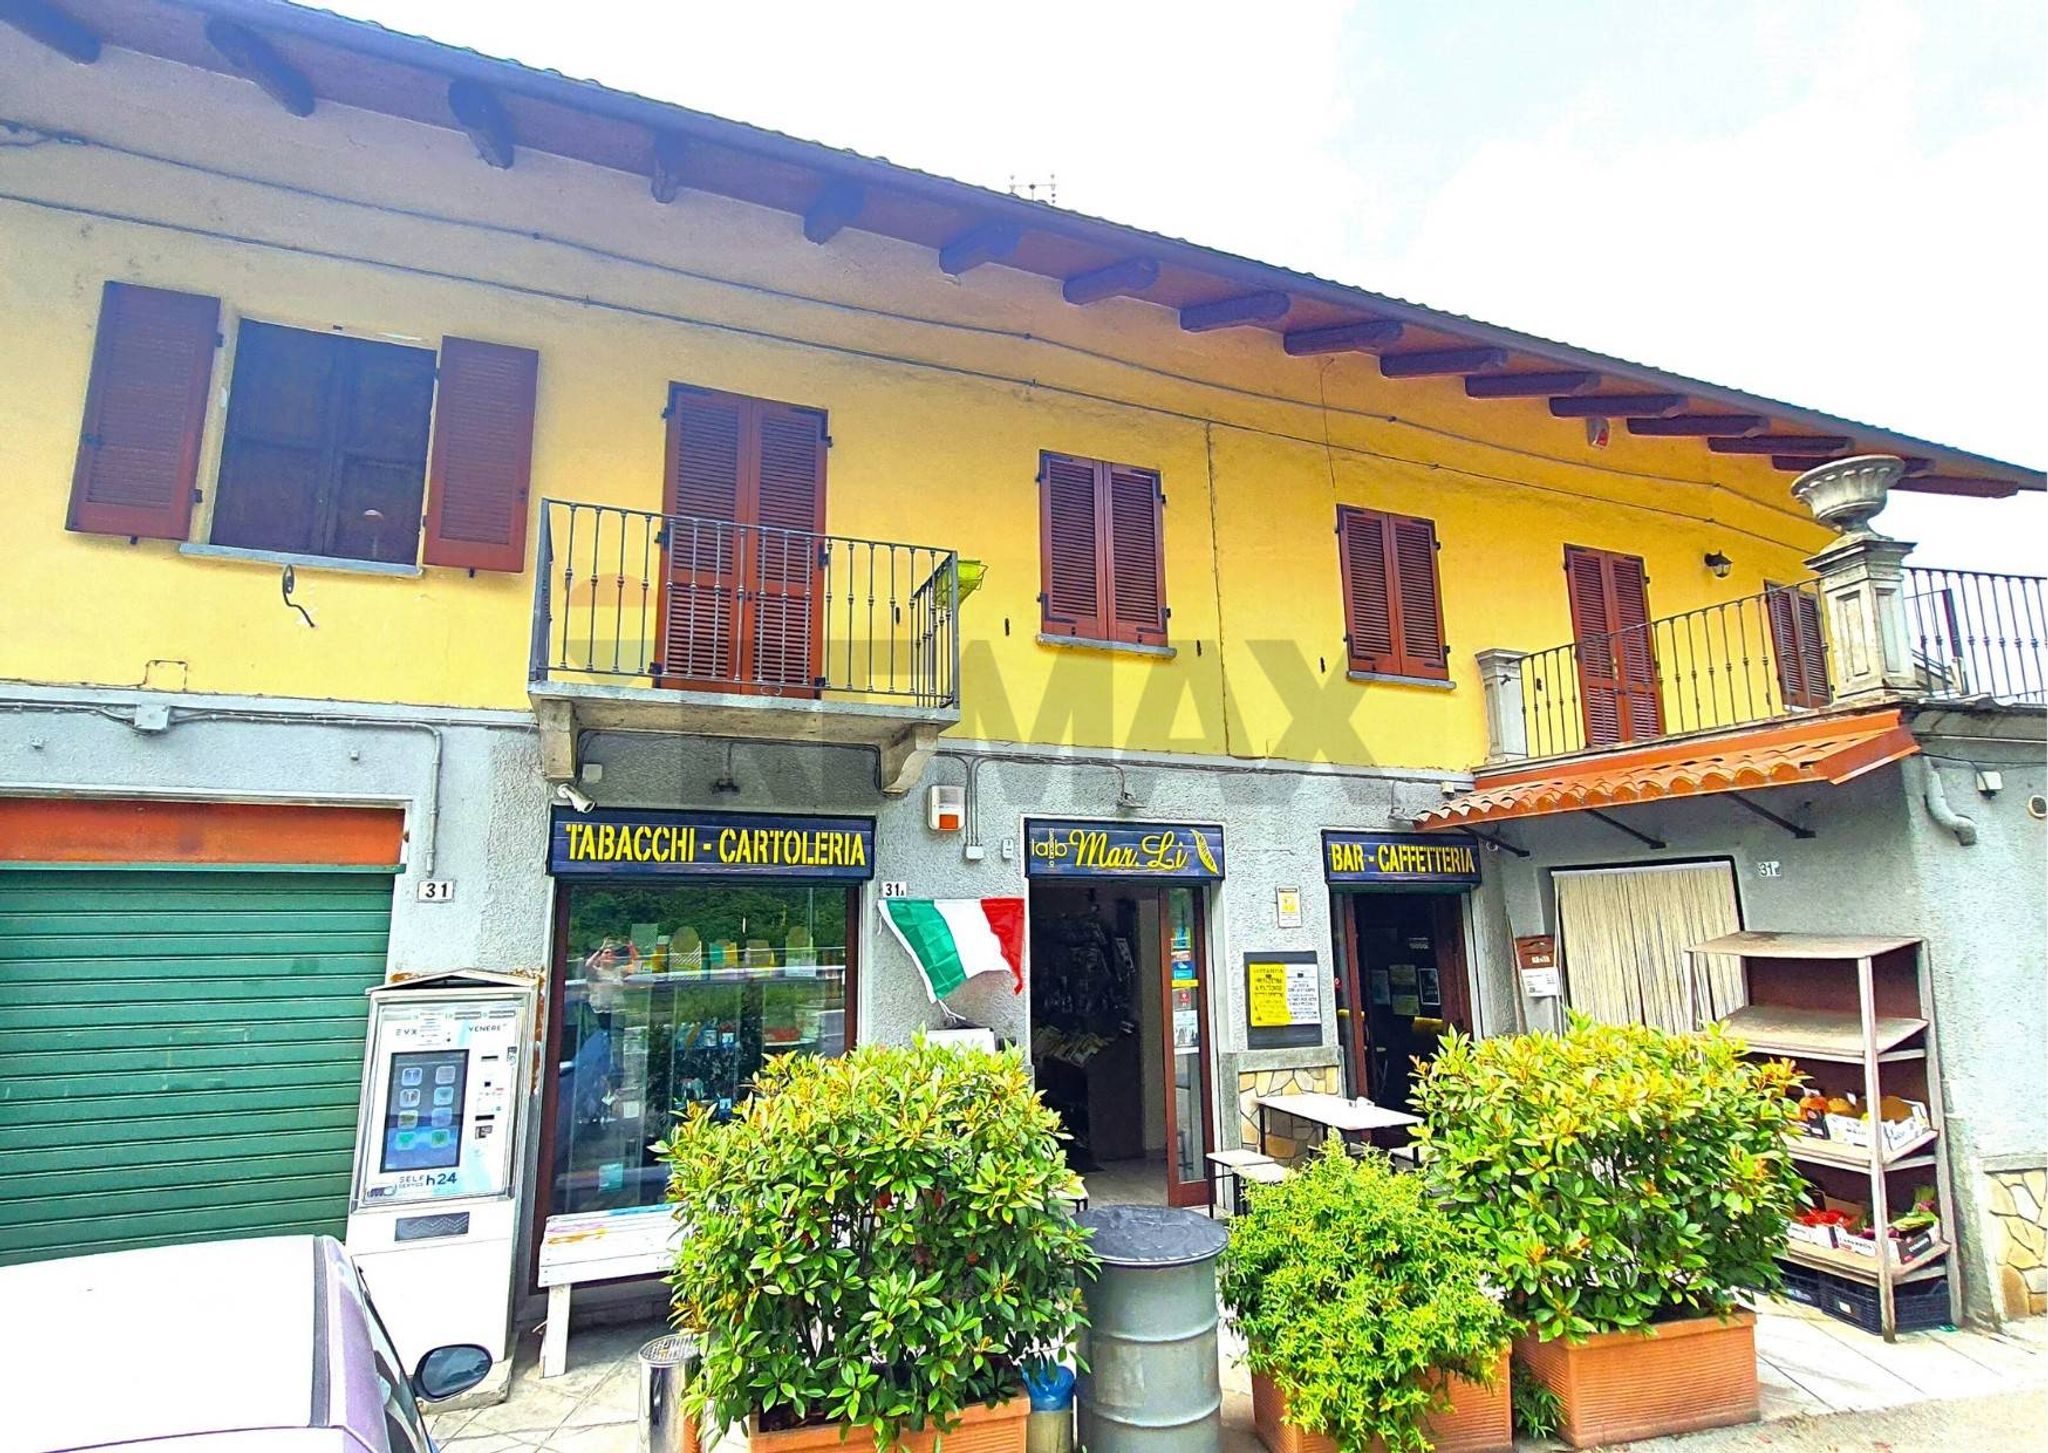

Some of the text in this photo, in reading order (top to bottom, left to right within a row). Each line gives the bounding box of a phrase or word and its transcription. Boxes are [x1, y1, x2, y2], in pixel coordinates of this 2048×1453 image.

[565, 823, 867, 867] TABACCHI - CARTOLERIA
[1141, 830, 1189, 871] Li
[1330, 843, 1365, 872] BAR
[1377, 844, 1476, 873] CAFFETTERIA
[425, 882, 448, 898] 31
[399, 1171, 458, 1186] SELF h24
